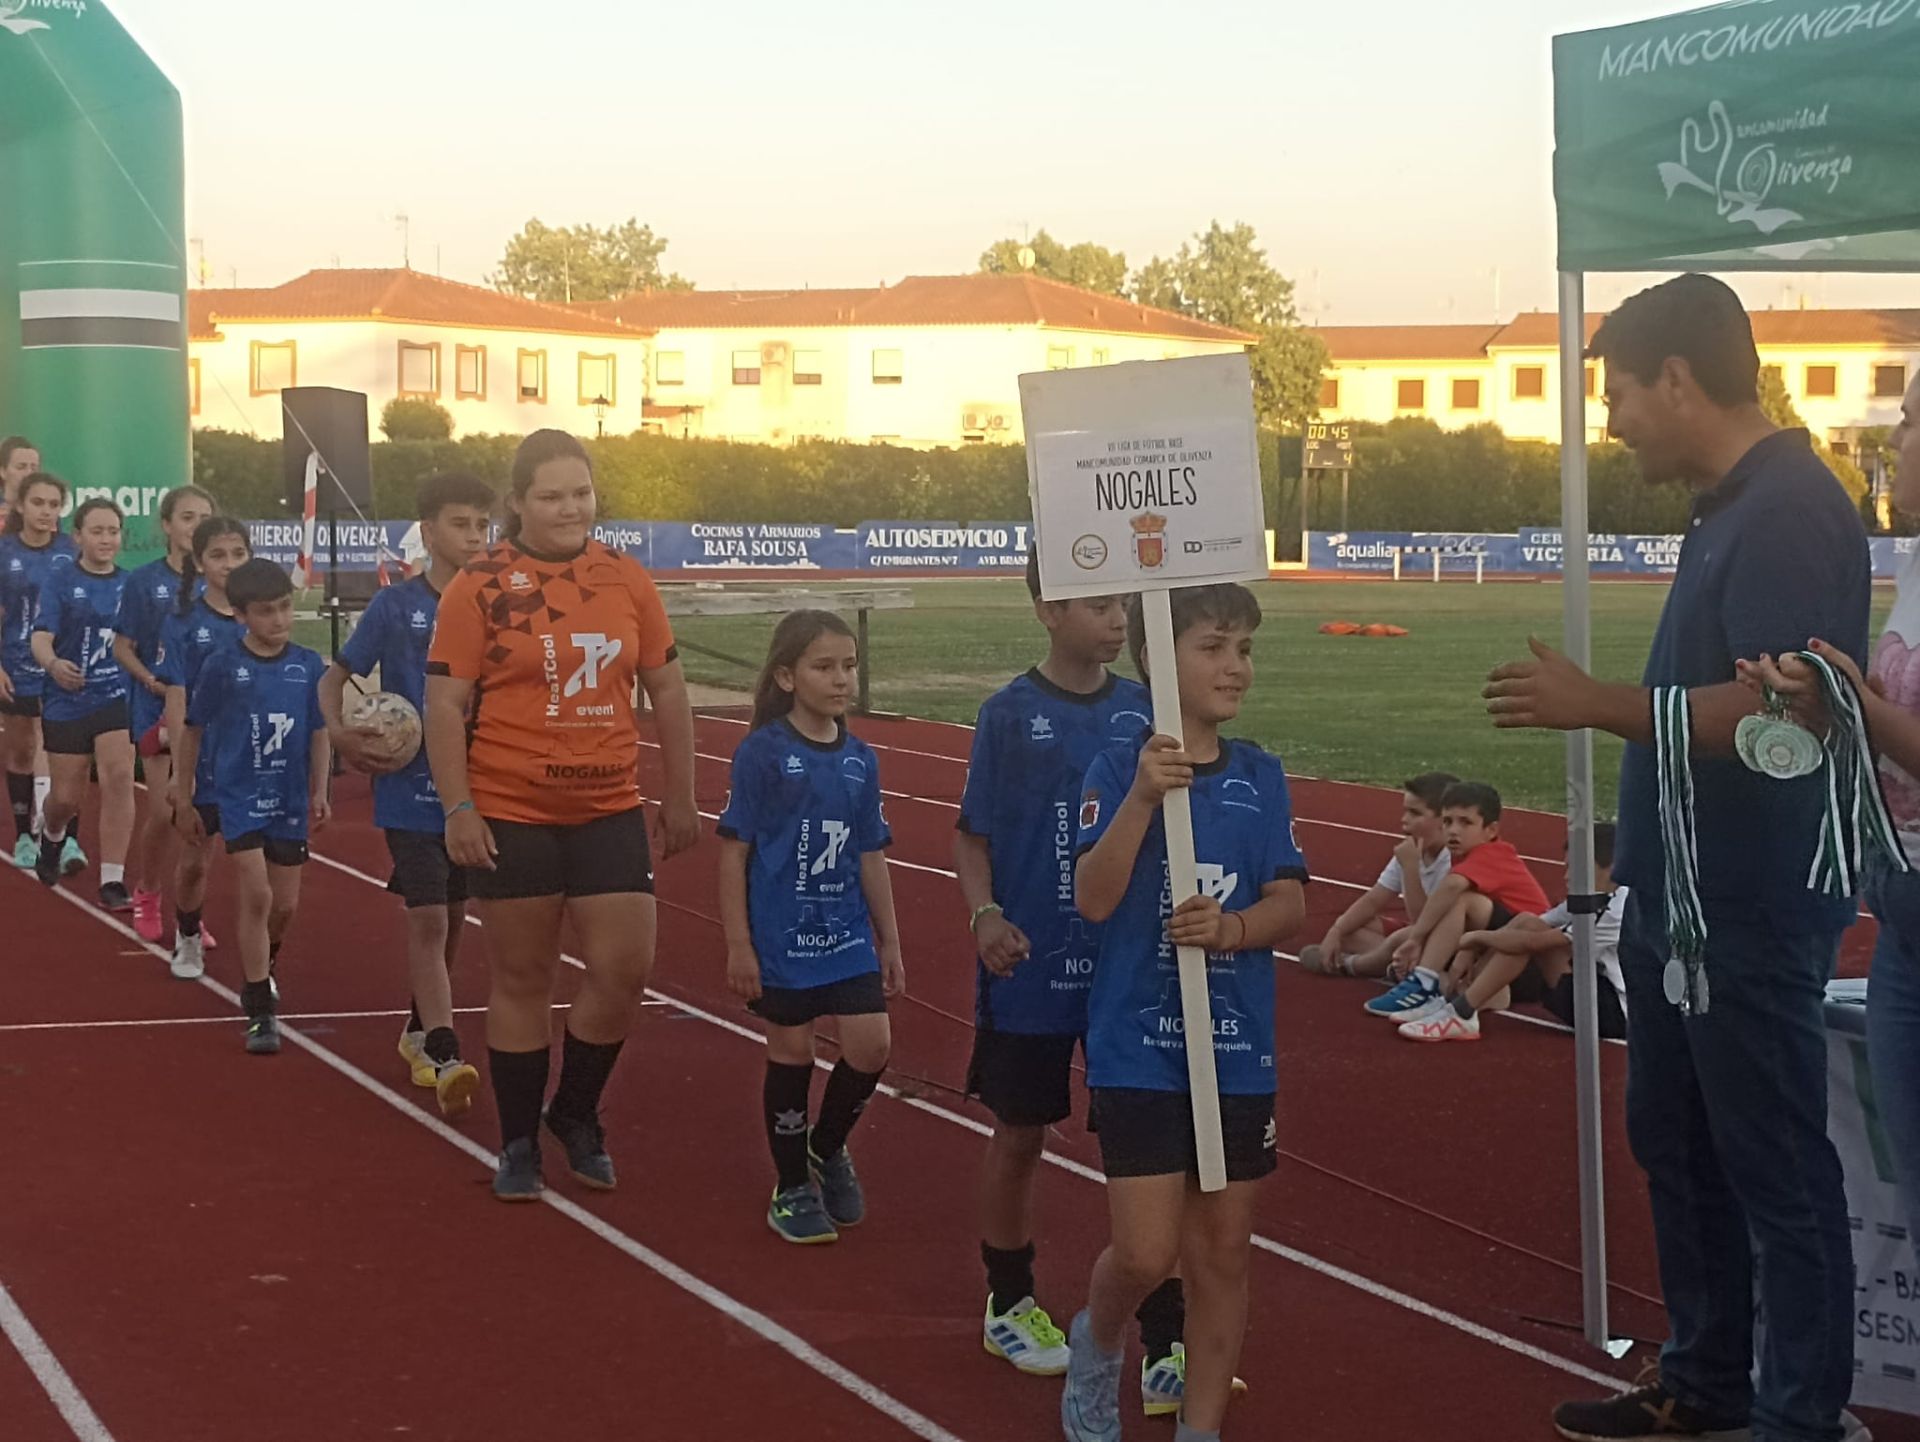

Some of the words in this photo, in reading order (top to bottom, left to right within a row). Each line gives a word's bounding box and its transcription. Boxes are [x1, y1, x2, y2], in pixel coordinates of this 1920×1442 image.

[1598, 0, 1914, 81] MANCOMUNIDAD
[1134, 454, 1166, 465] COMARCA
[1168, 453, 1177, 463] DE
[1180, 450, 1213, 463] OLIVENZA
[1095, 466, 1198, 512] NOGALES
[250, 525, 303, 547] HIERRO
[595, 525, 643, 553] Amigos
[865, 528, 1009, 549] AUTOSERVICIO
[1531, 533, 1617, 545] CERZAS
[704, 540, 748, 557] RAFA
[752, 540, 808, 557] SOUSA
[1336, 540, 1395, 562] aqualia
[1522, 547, 1625, 562] VICRIA
[1634, 541, 1682, 554] ALMA
[1643, 554, 1679, 565] OLIV
[576, 703, 615, 717] event
[1054, 801, 1072, 901] HeaTCool
[1158, 1016, 1239, 1037] NOLES
